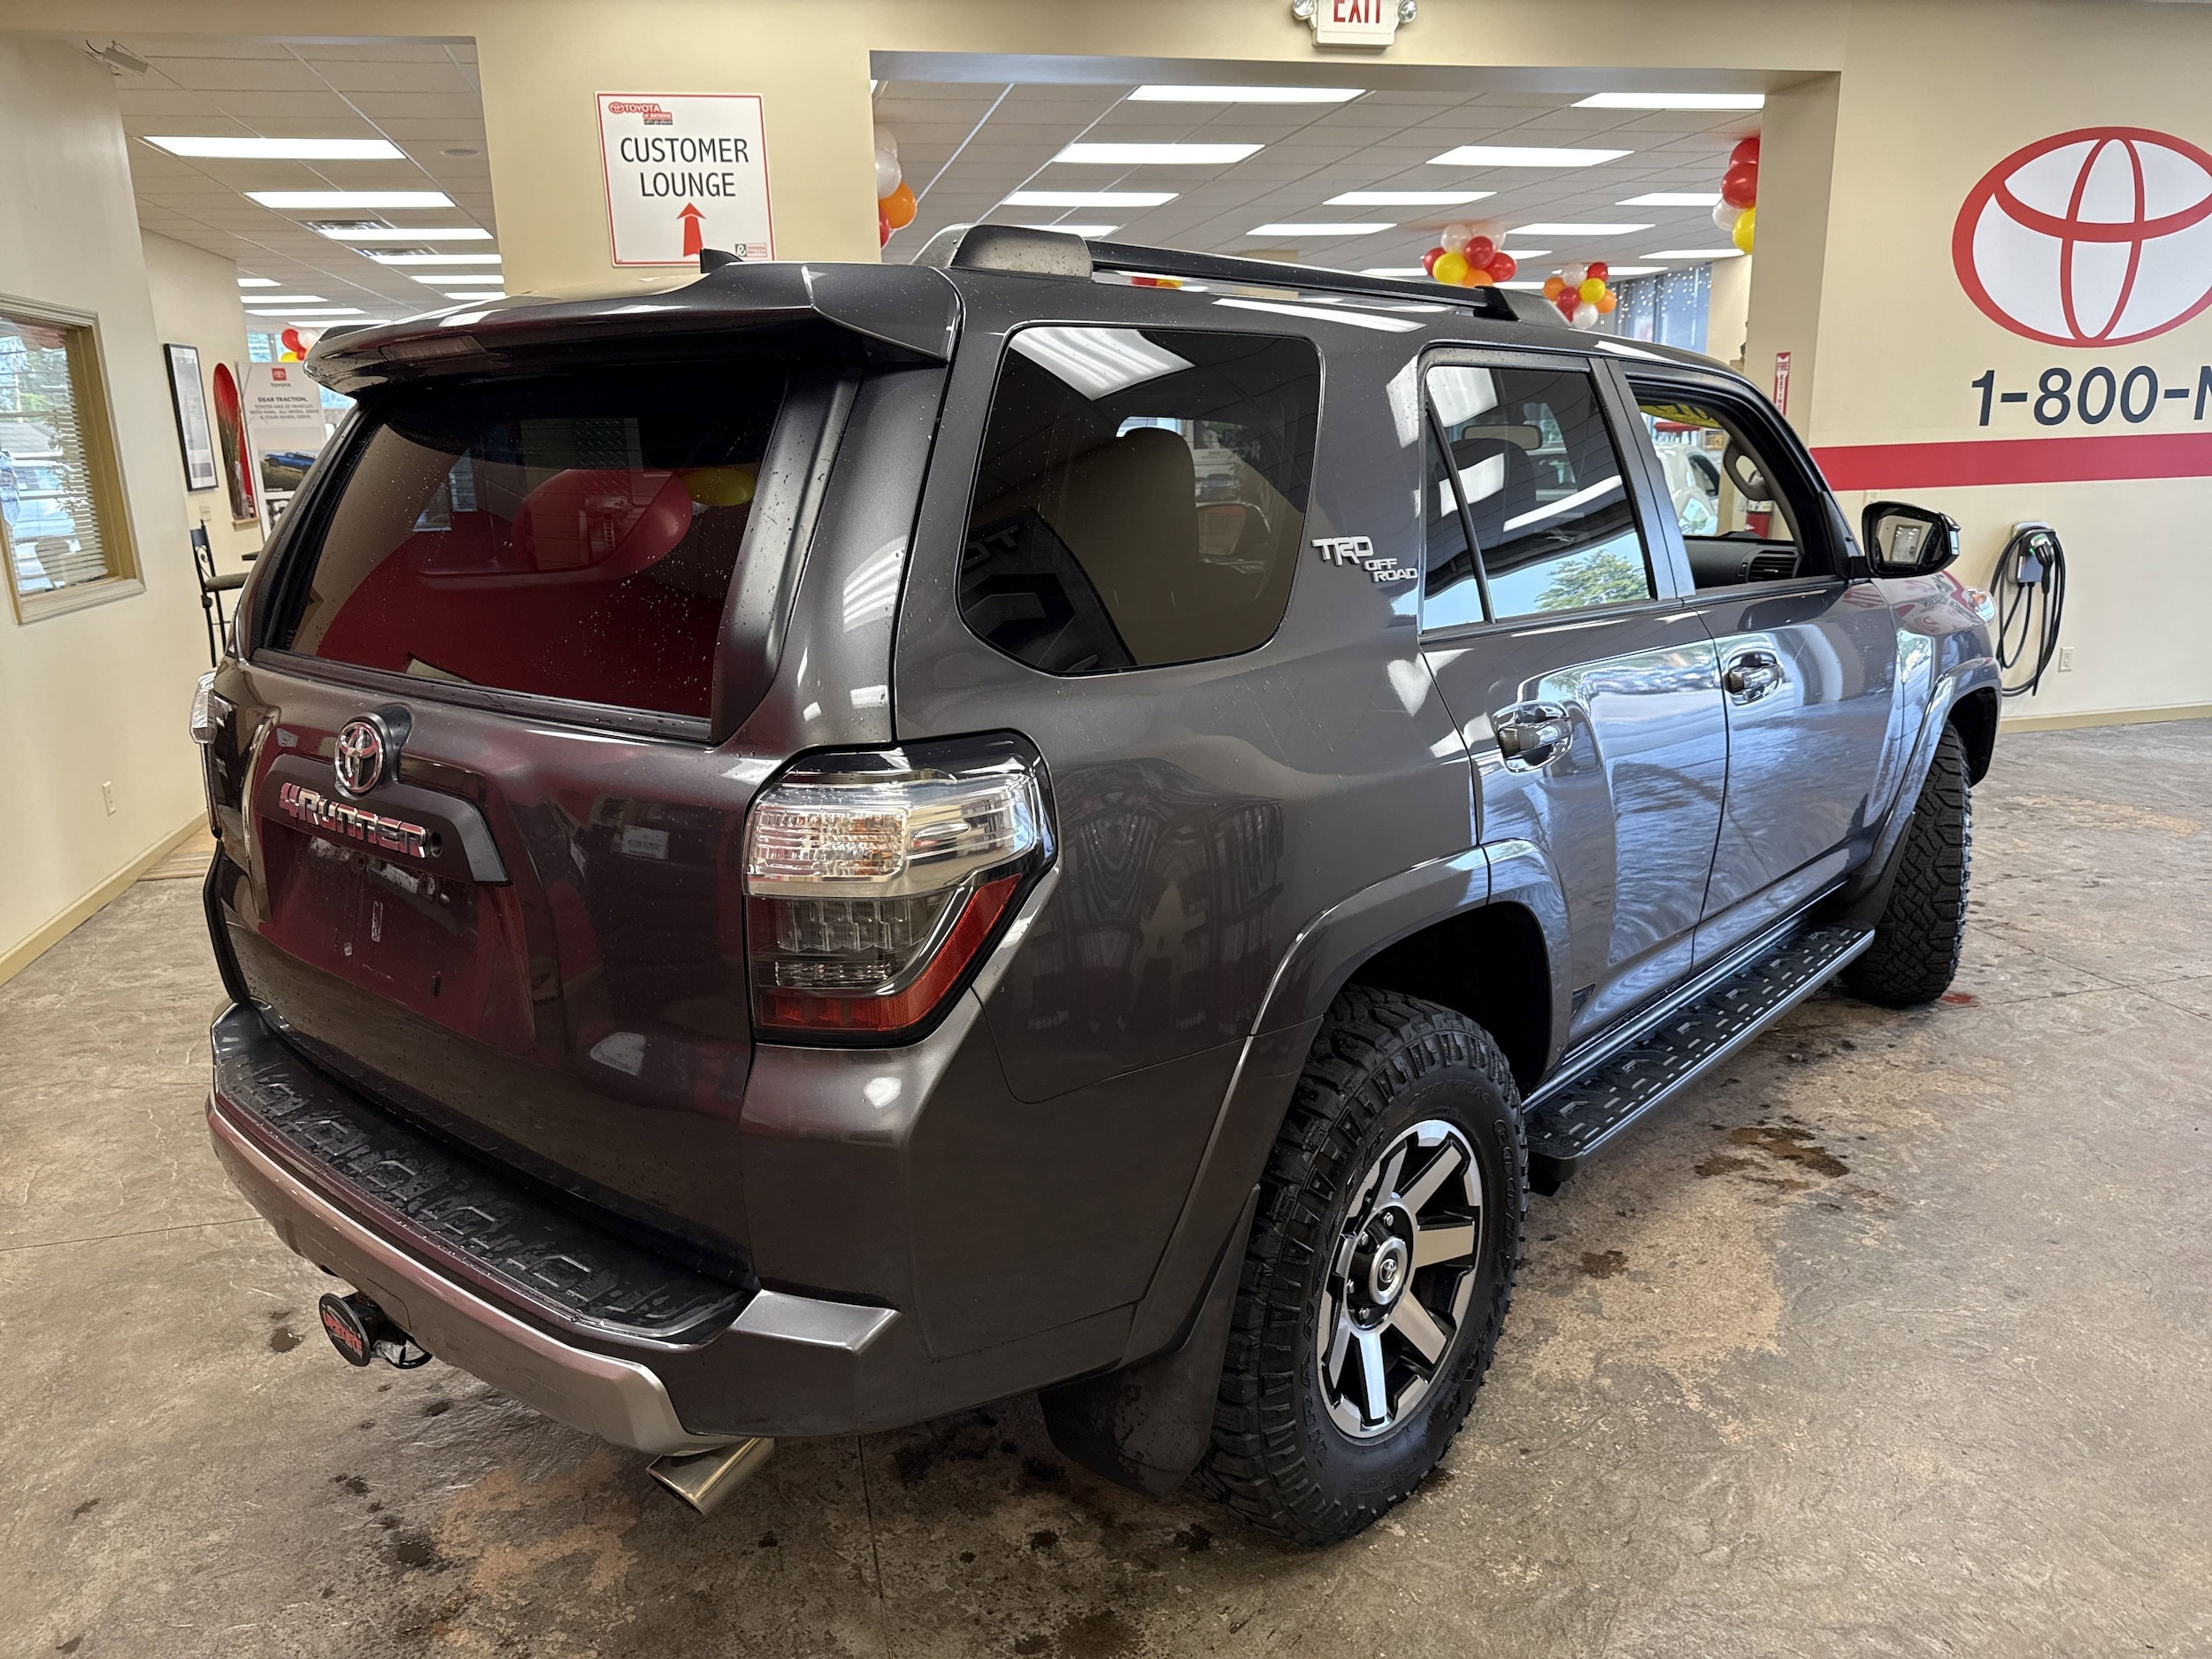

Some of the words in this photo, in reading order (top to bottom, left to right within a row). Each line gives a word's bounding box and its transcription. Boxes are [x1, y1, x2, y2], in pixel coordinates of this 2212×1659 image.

[624, 104, 661, 112] TOYOTA
[620, 137, 749, 163] CUSTOMER
[640, 172, 736, 197] LOUNGE
[1311, 535, 1374, 566] TRD
[1364, 557, 1397, 572] OFF
[1372, 568, 1418, 583] ROAD
[279, 782, 427, 859] 4RUNNER
